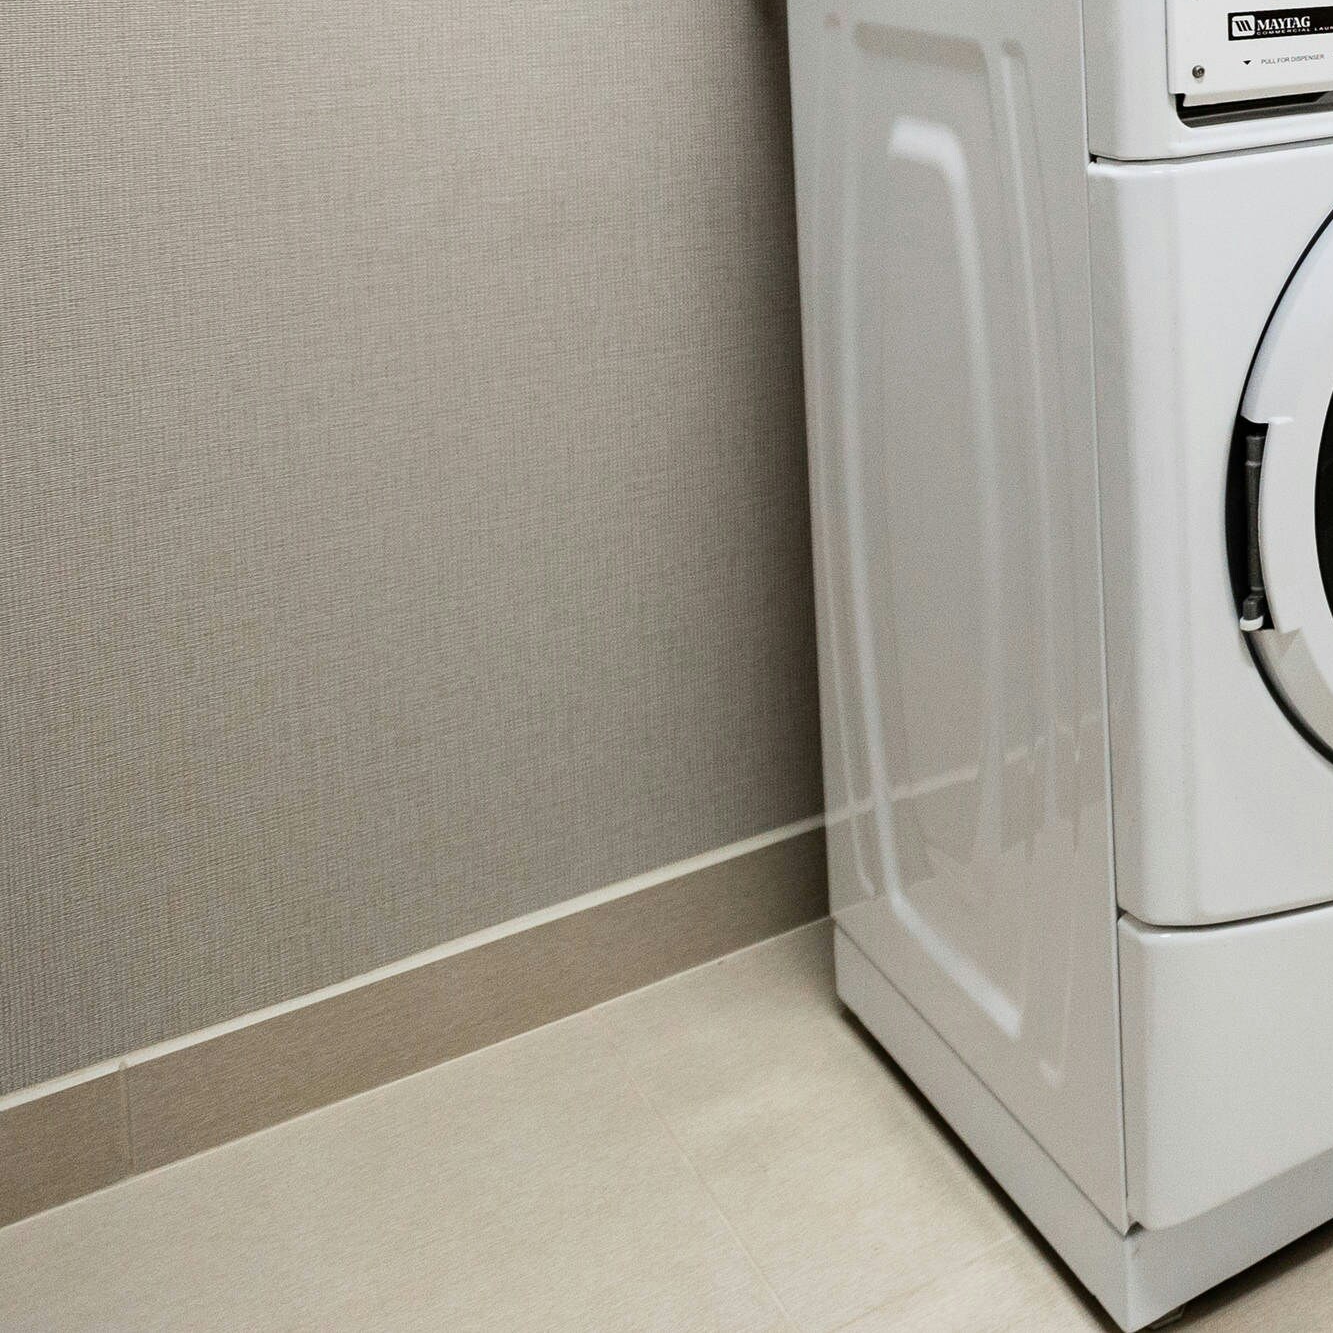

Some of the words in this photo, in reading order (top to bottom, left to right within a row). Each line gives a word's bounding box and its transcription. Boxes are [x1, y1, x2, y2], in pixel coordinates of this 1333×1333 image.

[1257, 16, 1310, 31] MAYTAG
[1256, 28, 1310, 36] COMMERCIAL
[1291, 53, 1324, 62] DISPENSER
